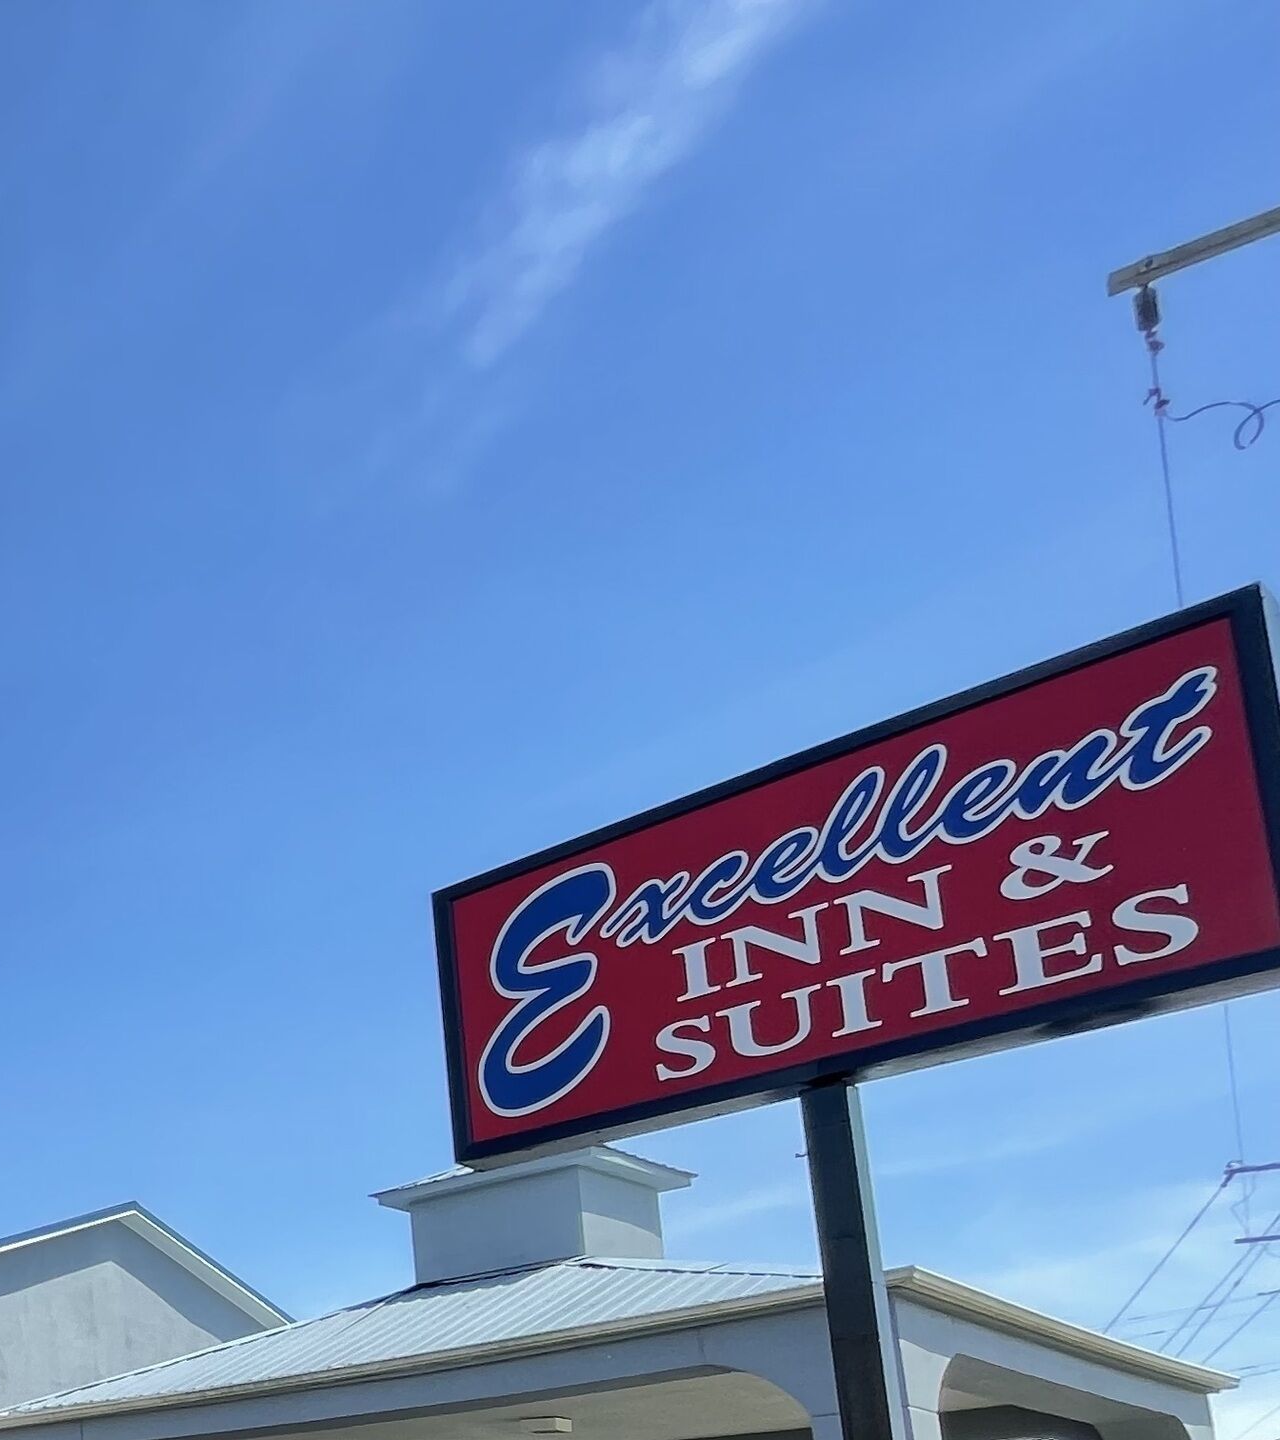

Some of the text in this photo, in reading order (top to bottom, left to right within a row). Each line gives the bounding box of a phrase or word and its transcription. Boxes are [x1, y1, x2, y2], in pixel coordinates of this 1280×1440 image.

[477, 664, 1219, 1118] Excellent
[655, 883, 1200, 1083] SUITES
[672, 829, 1114, 1003] INN &
